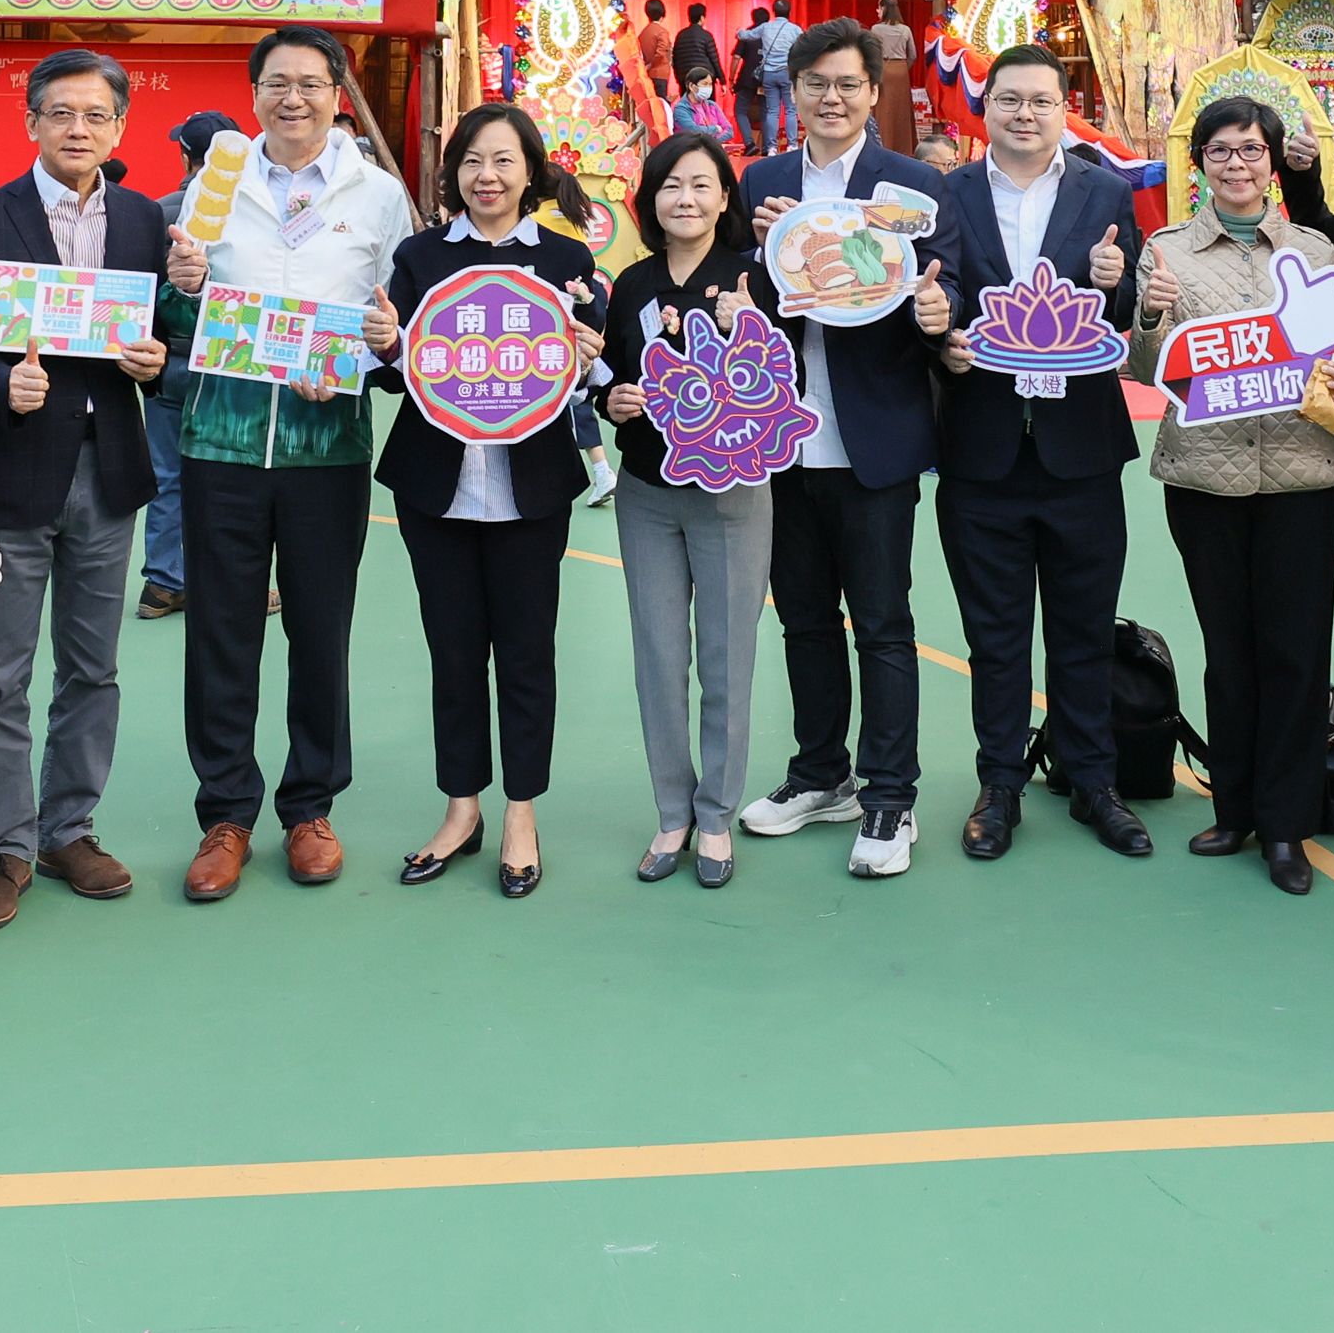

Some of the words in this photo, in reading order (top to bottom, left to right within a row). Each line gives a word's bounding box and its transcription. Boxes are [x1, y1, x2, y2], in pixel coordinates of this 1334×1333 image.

[456, 303, 531, 334] 南區
[421, 344, 565, 373] 繽紛市集
[1186, 319, 1275, 373] 民政
[1019, 377, 1063, 395] 水燈
